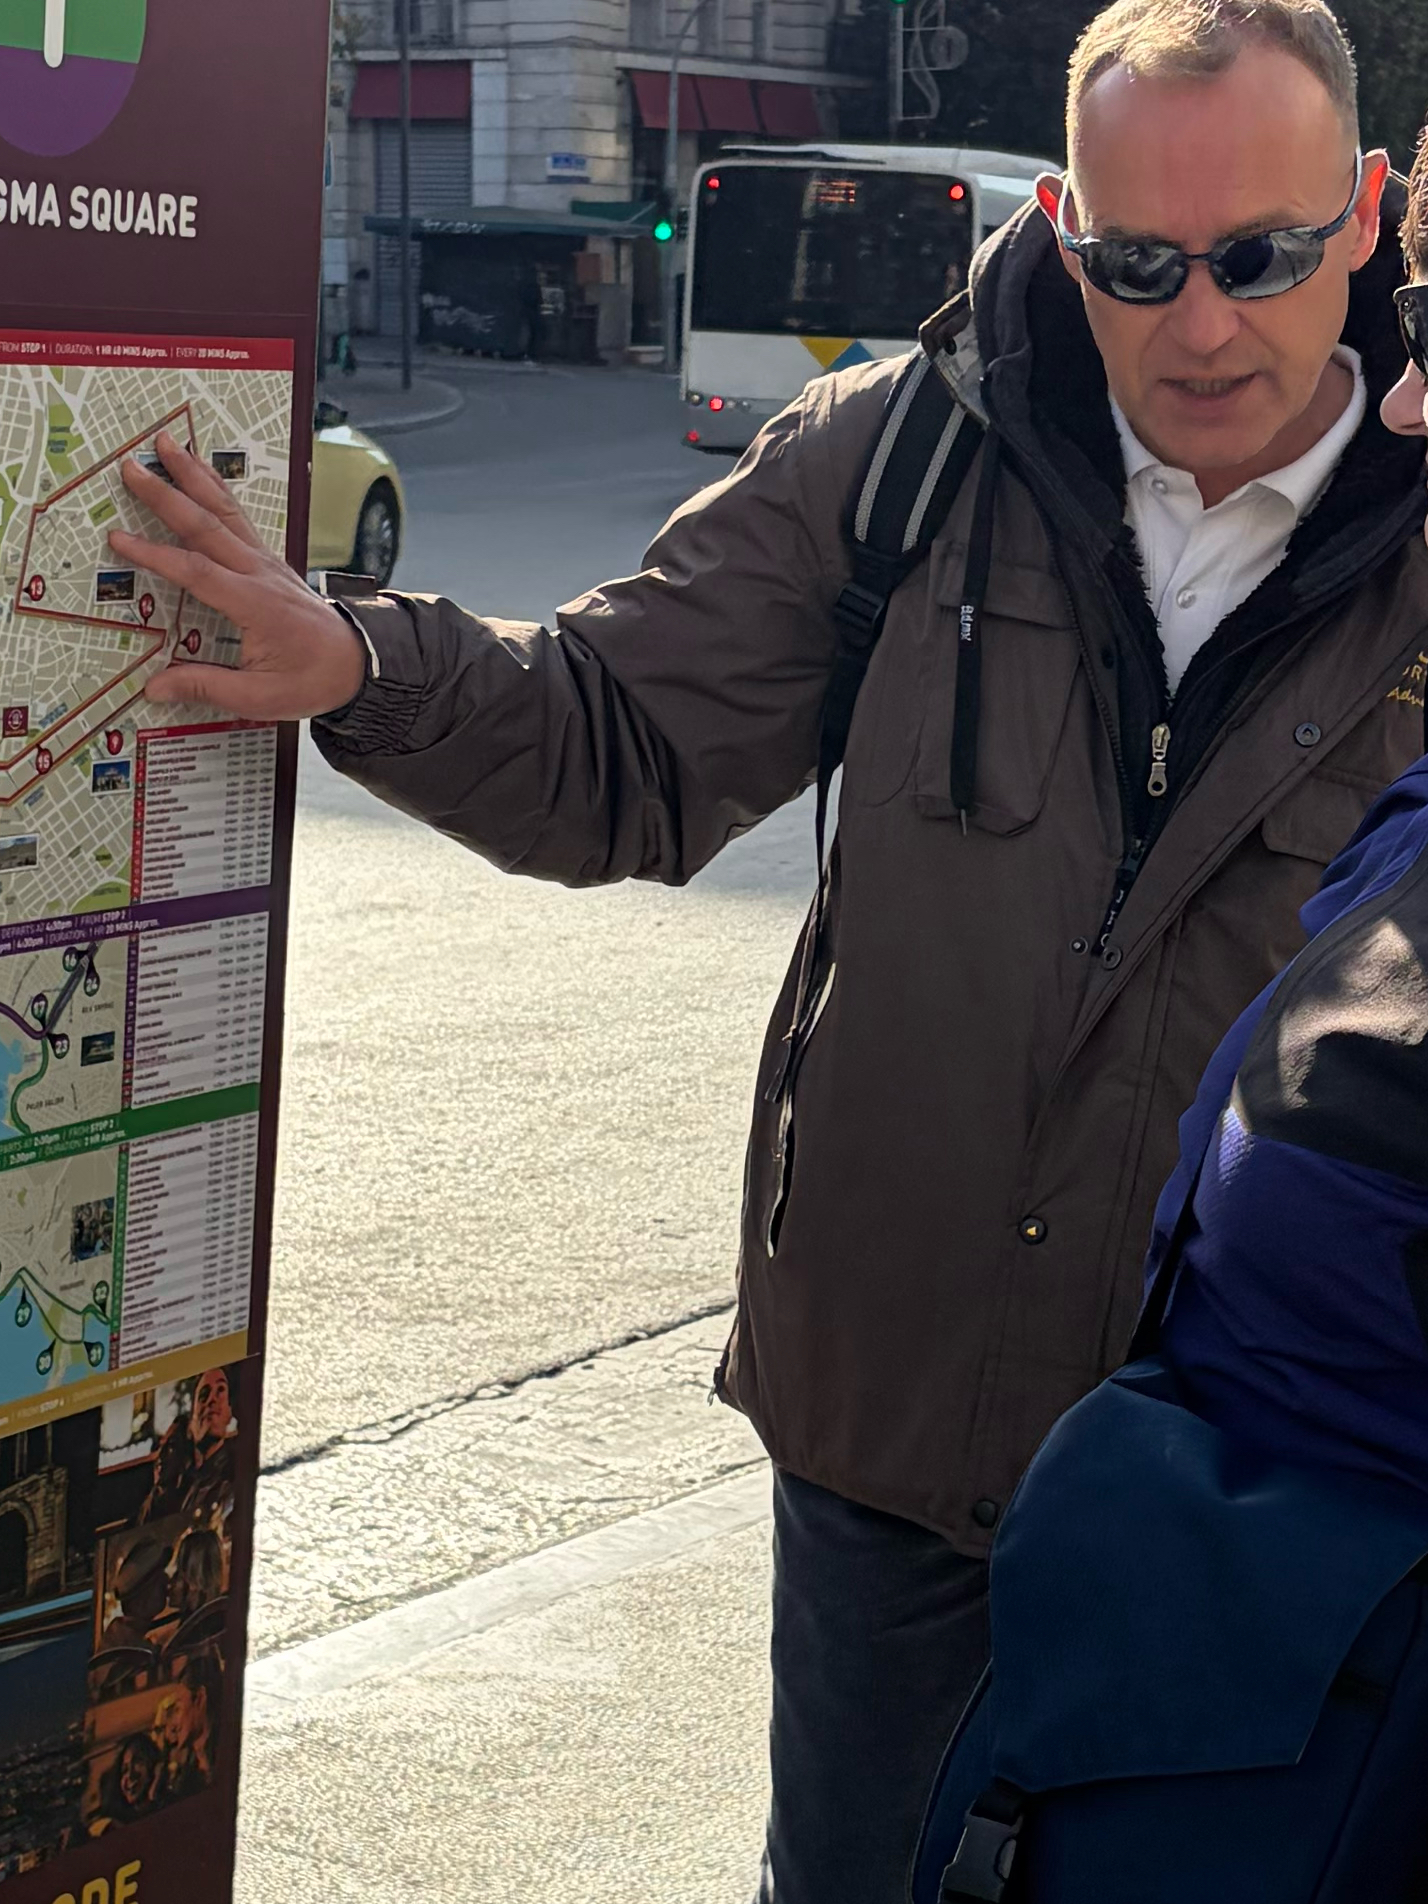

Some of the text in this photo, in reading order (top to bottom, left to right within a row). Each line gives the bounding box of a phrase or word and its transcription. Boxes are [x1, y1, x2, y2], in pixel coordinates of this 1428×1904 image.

[68, 185, 199, 239] SQUARE
[21, 342, 40, 354] STOP
[38, 755, 51, 768] 15
[103, 911, 120, 923] STOP
[65, 953, 77, 967] 16
